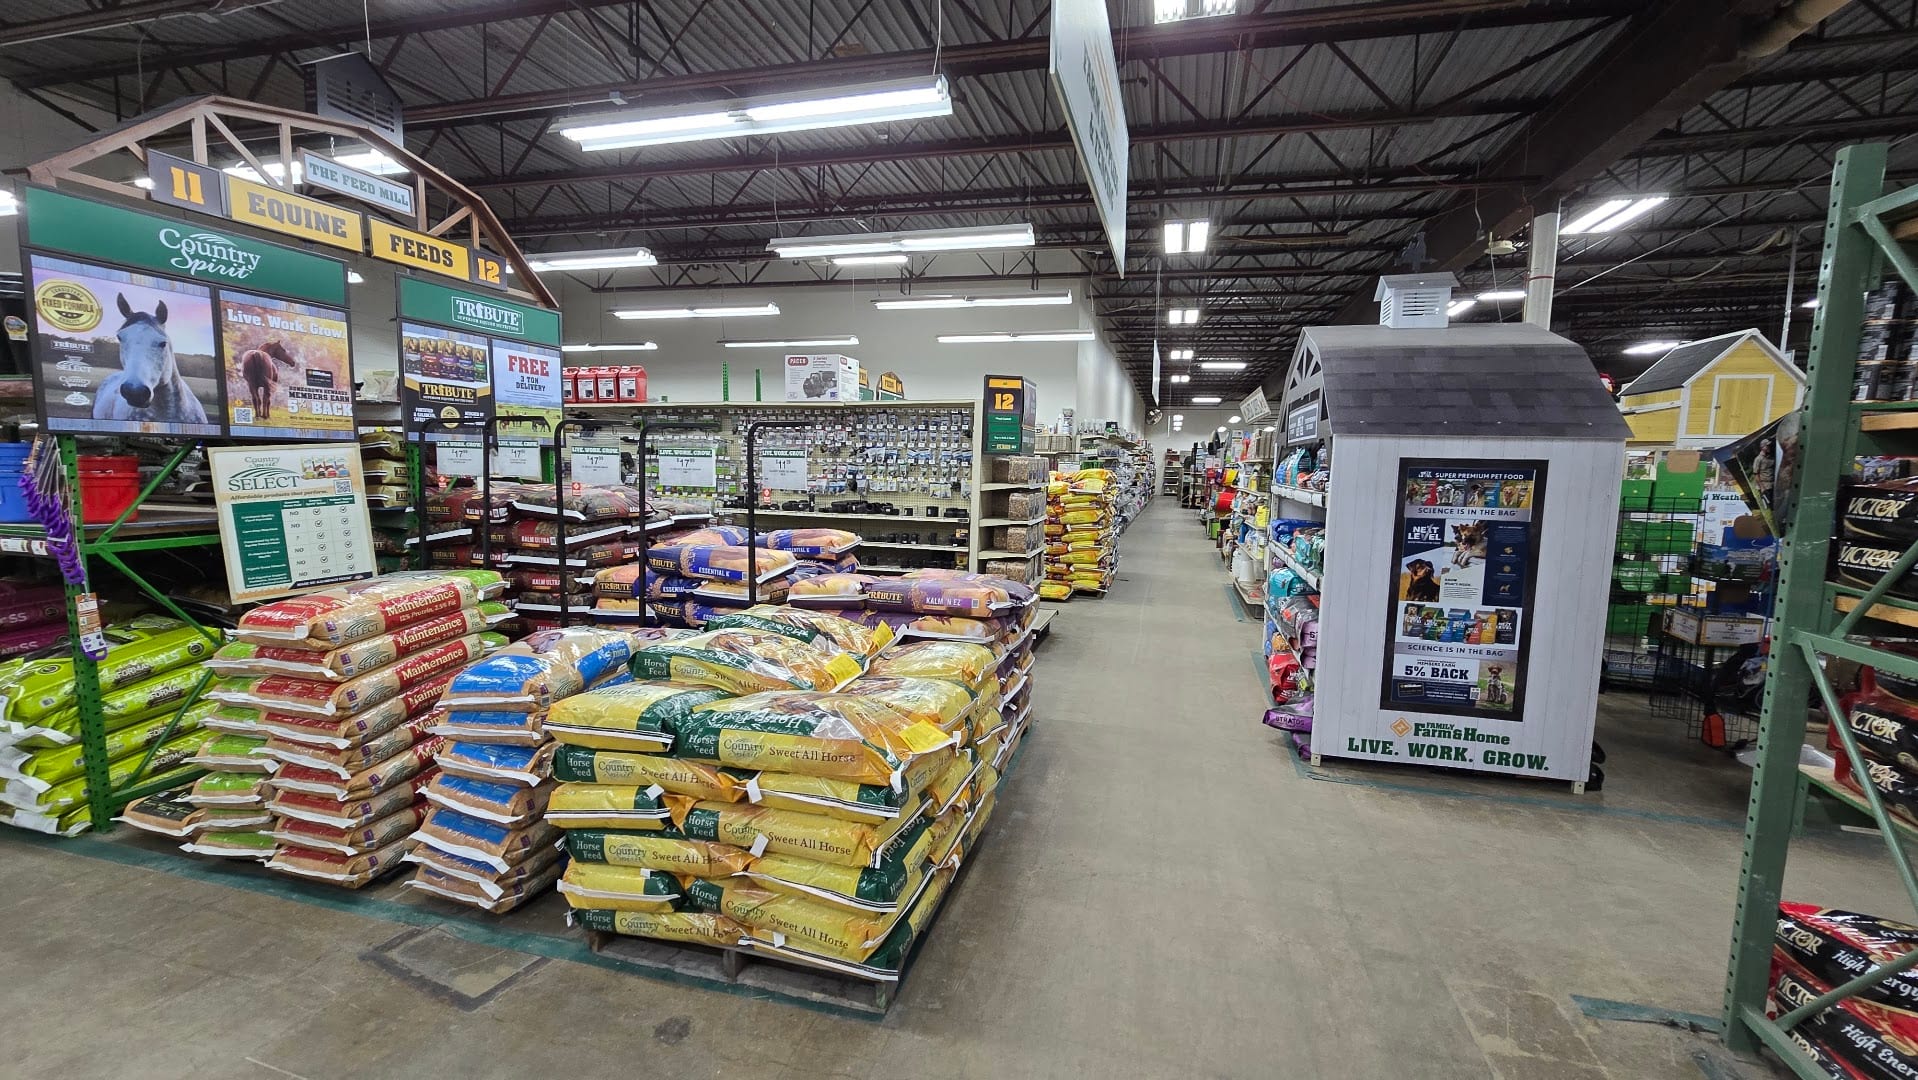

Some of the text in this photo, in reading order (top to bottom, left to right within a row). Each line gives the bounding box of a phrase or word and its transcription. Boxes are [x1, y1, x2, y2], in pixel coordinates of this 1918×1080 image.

[171, 166, 204, 204] 11
[309, 162, 409, 207] THE FEED MILL
[248, 191, 347, 238] EQUINE
[159, 228, 261, 271] Country
[390, 234, 454, 268] FEEDS
[170, 249, 252, 279] Spirit
[478, 258, 500, 284] 12
[42, 297, 94, 313] FIXED FORMULA
[456, 300, 519, 326] TRIBUTE
[227, 308, 346, 339] Live. Work. Grow.
[508, 355, 549, 377] FREE
[422, 383, 475, 399] TRIBUTE
[516, 381, 546, 392] DELIVERY
[289, 392, 349, 402] MEMBERS EARN
[994, 393, 1014, 410] 12
[311, 402, 352, 416] BACK
[245, 456, 280, 466] Country
[229, 476, 299, 492] SELECT
[1417, 507, 1454, 515] SCIENCE
[1847, 497, 1907, 518] VICTOR
[1407, 532, 1441, 541] LEVEL
[1412, 523, 1440, 534] NEXT
[1838, 545, 1901, 568] VICTOR
[698, 567, 725, 577] ESSENTIAL
[600, 582, 631, 591] TRIBUTE
[386, 589, 455, 617] Maintenance
[866, 591, 904, 601] TRIBUTE
[926, 597, 944, 606] KALM
[411, 607, 434, 619] Protein,
[344, 622, 380, 641] SELECT
[399, 617, 462, 646] Maintenance
[1407, 644, 1442, 652] SCIENCE
[357, 655, 389, 673] SELECT
[402, 647, 464, 680] Maintenance
[644, 658, 667, 668] Horse
[648, 667, 667, 676] Feed
[1405, 665, 1469, 680] 5% BACK
[408, 683, 447, 705] Mainten
[1275, 716, 1305, 727] STRATOS
[1426, 722, 1455, 730] FAMILY
[689, 734, 715, 745] Horse
[694, 745, 714, 755] Feed
[724, 739, 856, 763] Country Sweet All Horse
[1347, 737, 1549, 771] LIVE. WORK. GROW.
[568, 757, 591, 768] Horse
[573, 768, 591, 777] Feed
[599, 761, 687, 782] Country Sweet All
[688, 815, 715, 828] Horse
[692, 826, 714, 836] Feed
[577, 840, 600, 850] Horse
[768, 832, 798, 846] Sweet
[800, 838, 816, 849] All
[819, 841, 851, 855] Horse
[583, 850, 601, 860] Feed
[608, 845, 699, 863] Country Sweet All
[691, 885, 718, 902] Horse
[586, 912, 611, 923] Horse
[726, 901, 849, 950] Country Sweet All Horse
[592, 922, 612, 931] Feed
[620, 917, 710, 937] Country Sweet All
[1832, 949, 1866, 973] High
[1841, 1023, 1878, 1053] High
